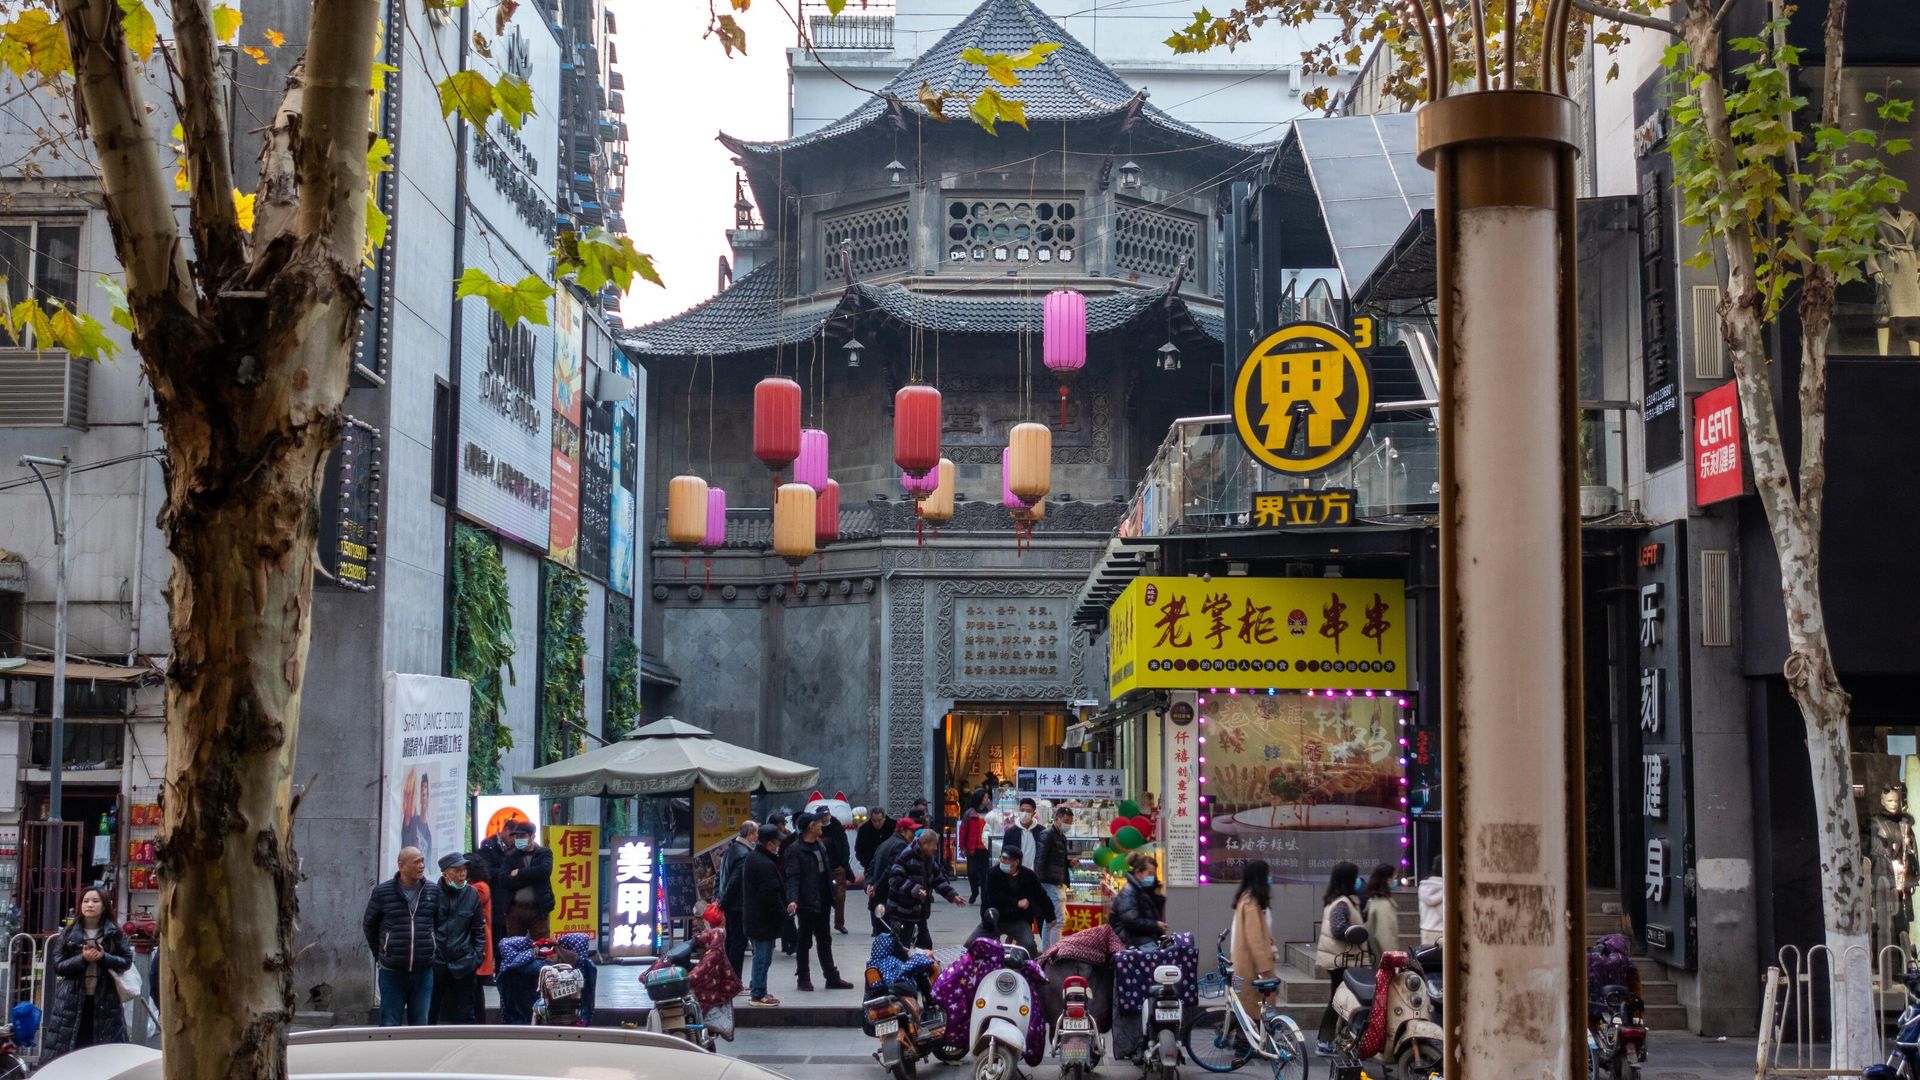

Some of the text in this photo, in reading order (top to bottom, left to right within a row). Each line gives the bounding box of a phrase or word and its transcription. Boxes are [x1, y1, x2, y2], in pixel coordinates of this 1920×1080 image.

[1700, 406, 1732, 447] LEFIT
[1700, 442, 1736, 478] 乐刻健身
[1254, 494, 1351, 526] 界立方
[1153, 592, 1279, 650] 老掌柜
[1319, 592, 1391, 655] 串串
[1148, 659, 1396, 672] 来自的网红人气美食 名吃经典传承
[403, 714, 421, 732] SPARK
[423, 713, 442, 731] DANCE
[1640, 583, 1665, 903] 乐刻健身
[1038, 772, 1121, 787] 仟禧创意蛋糕
[1174, 730, 1190, 817] 仟禧创意蛋糕
[558, 829, 593, 921] 便利店
[616, 842, 653, 924] 美甲
